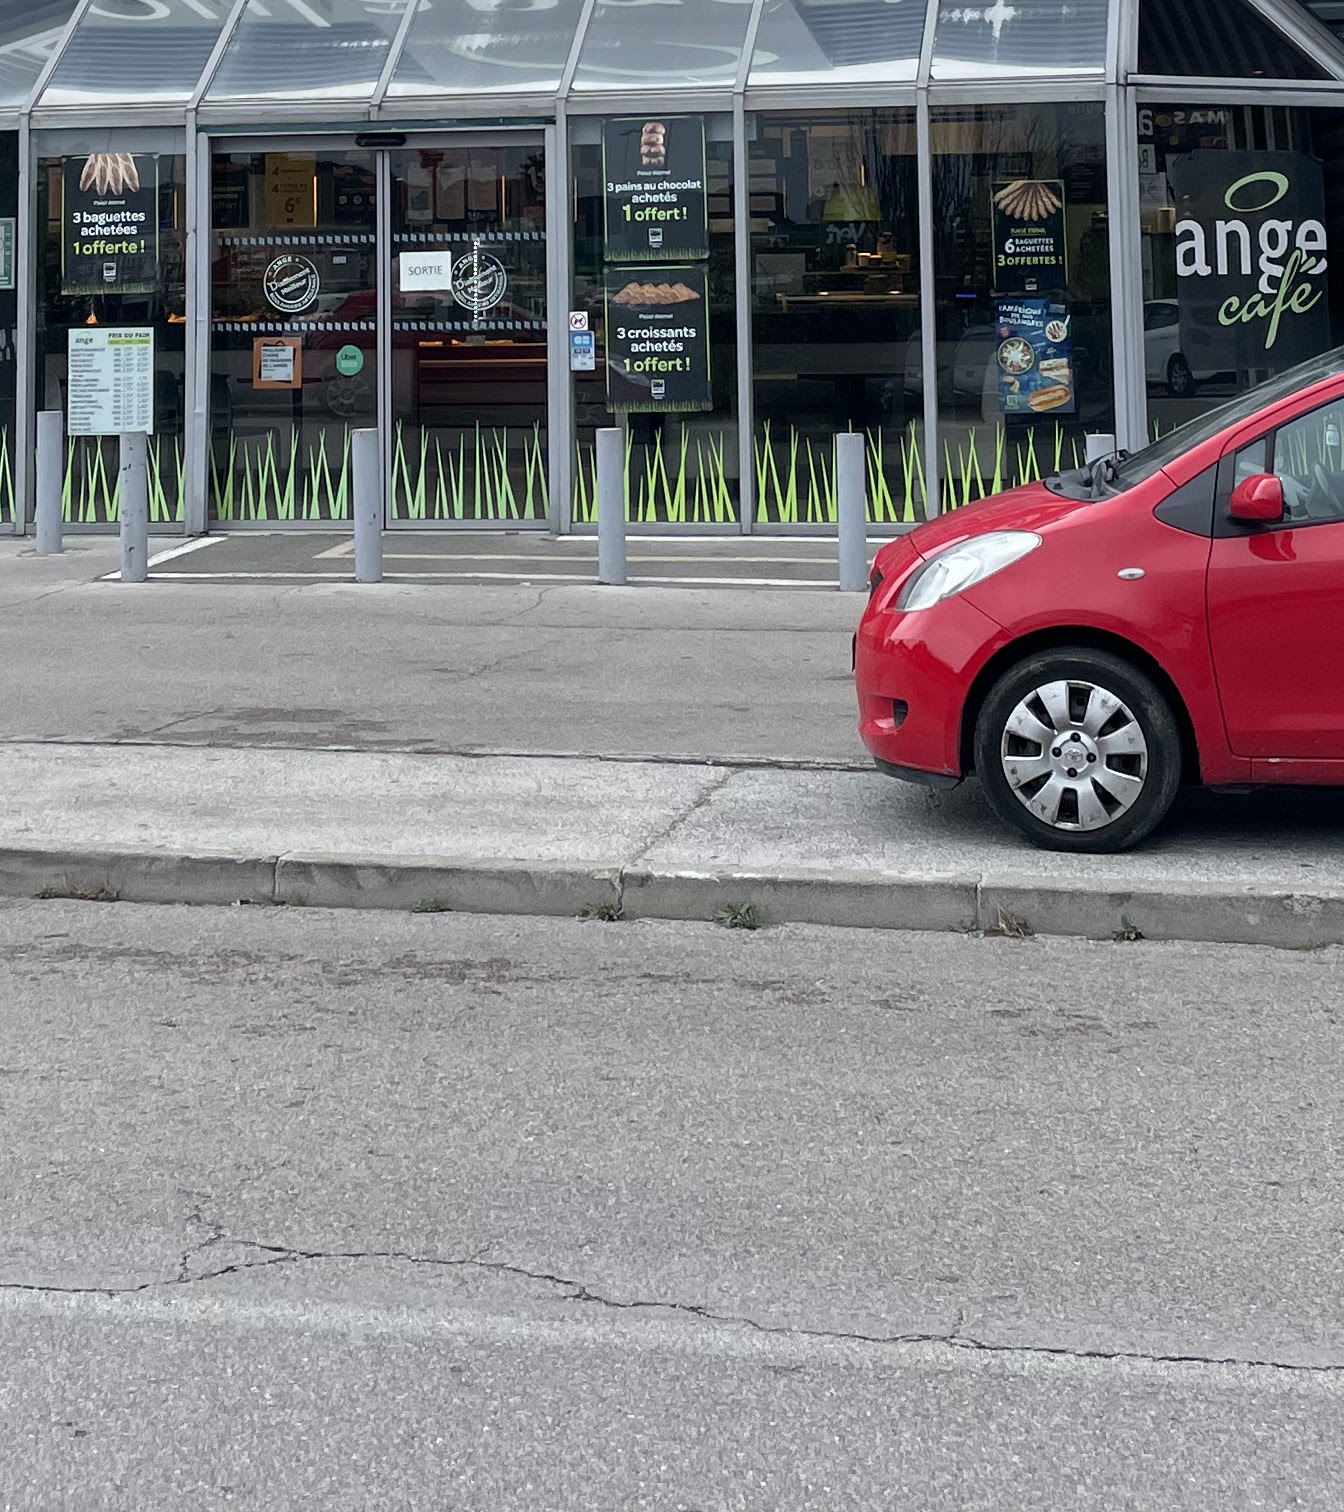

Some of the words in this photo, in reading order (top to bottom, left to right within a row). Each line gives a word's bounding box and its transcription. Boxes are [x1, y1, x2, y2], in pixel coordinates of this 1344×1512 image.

[607, 182, 614, 192] 3
[615, 181, 642, 194] pains
[644, 182, 656, 191] au
[657, 179, 702, 191] chocolat
[631, 191, 678, 203] achetés
[72, 212, 81, 224] 3
[82, 211, 146, 226] baguettes
[622, 204, 631, 222] 1
[80, 223, 138, 237] achetées
[73, 241, 80, 255] 1
[1004, 238, 1015, 254] 6
[1015, 244, 1054, 253] ACHETÉES
[997, 254, 1006, 267] 3
[1006, 255, 1057, 266] OFFERTES
[1175, 219, 1328, 294] ange
[407, 265, 444, 276] SORTIE
[1218, 249, 1323, 350] café
[616, 327, 626, 339] 3
[627, 326, 697, 339] croissants
[630, 340, 684, 353] achetés
[623, 357, 631, 372] 1
